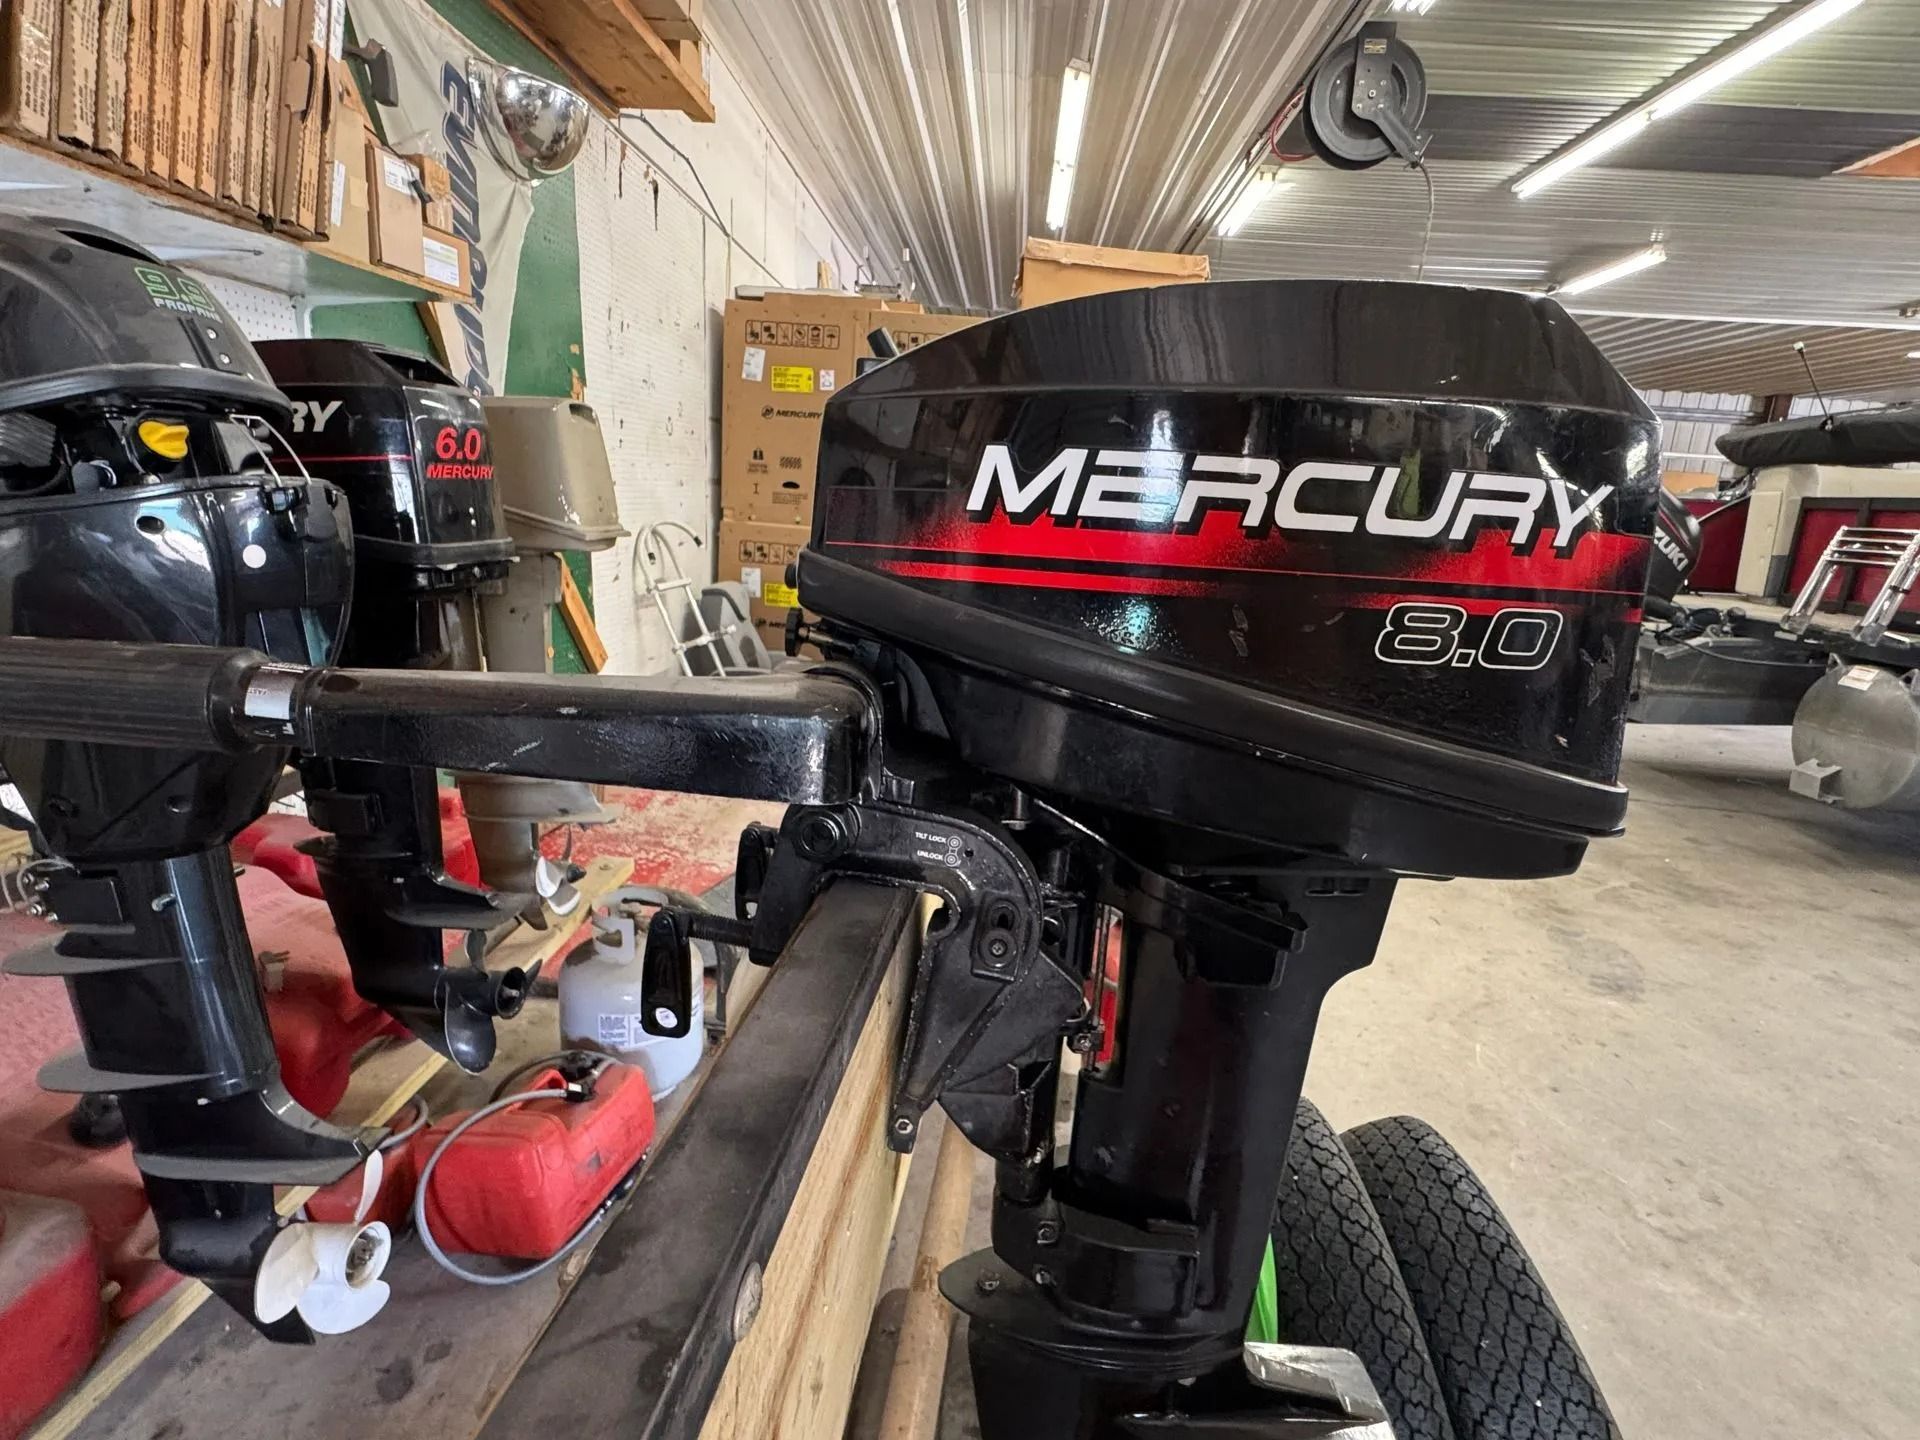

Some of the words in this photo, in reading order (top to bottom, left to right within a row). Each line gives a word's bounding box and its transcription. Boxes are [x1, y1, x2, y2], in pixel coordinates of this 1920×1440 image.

[775, 409, 822, 419] MERCURY
[435, 427, 481, 460] 6.0
[426, 464, 494, 480] MERCURY
[966, 444, 1614, 556] MERCURY
[1375, 602, 1564, 670] 8.0
[915, 831, 928, 840] TILT
[929, 833, 947, 844] LOCK
[917, 850, 943, 860] UNLOCK
